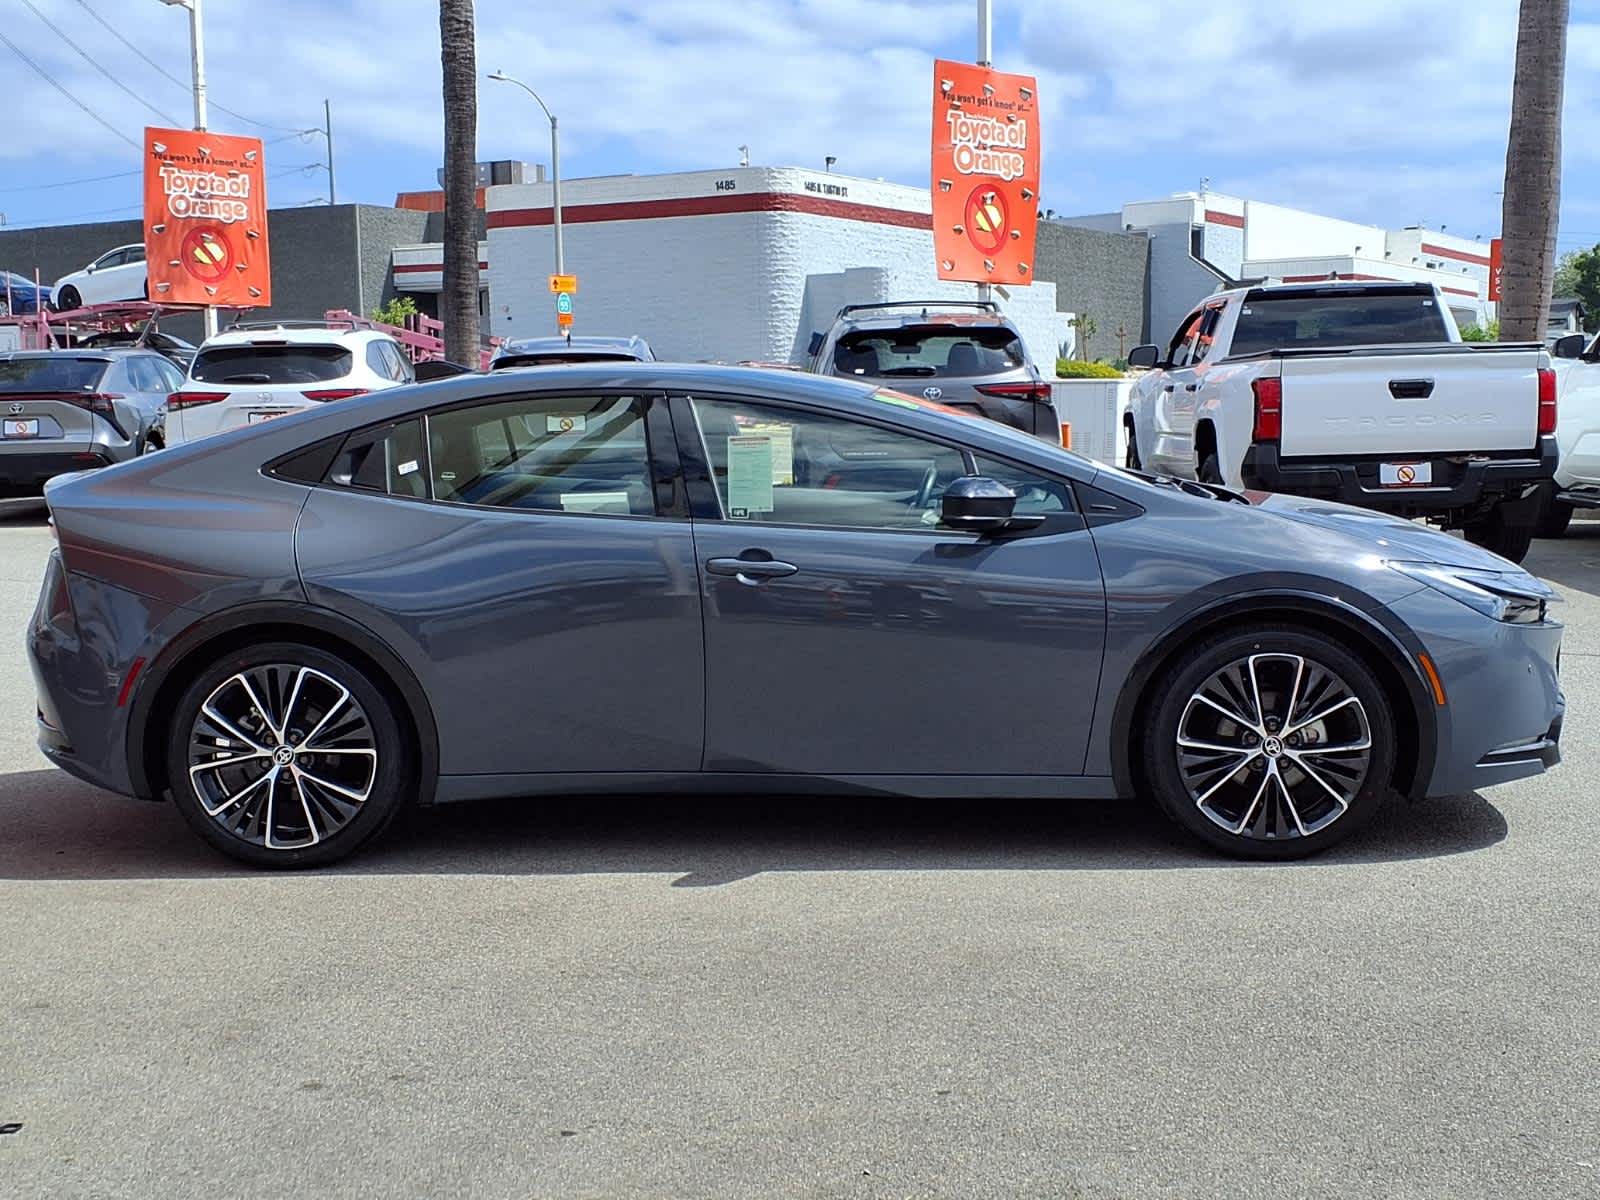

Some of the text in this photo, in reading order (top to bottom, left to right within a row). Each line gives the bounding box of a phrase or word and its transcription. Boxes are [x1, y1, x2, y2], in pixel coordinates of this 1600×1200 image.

[947, 111, 1026, 147] Toyota of
[954, 145, 1024, 180] Orange
[160, 167, 249, 197] Toyota of
[715, 180, 736, 191] 1485
[804, 181, 816, 192] 1485
[168, 193, 247, 222] Orange
[1323, 412, 1497, 428] TACOMA
